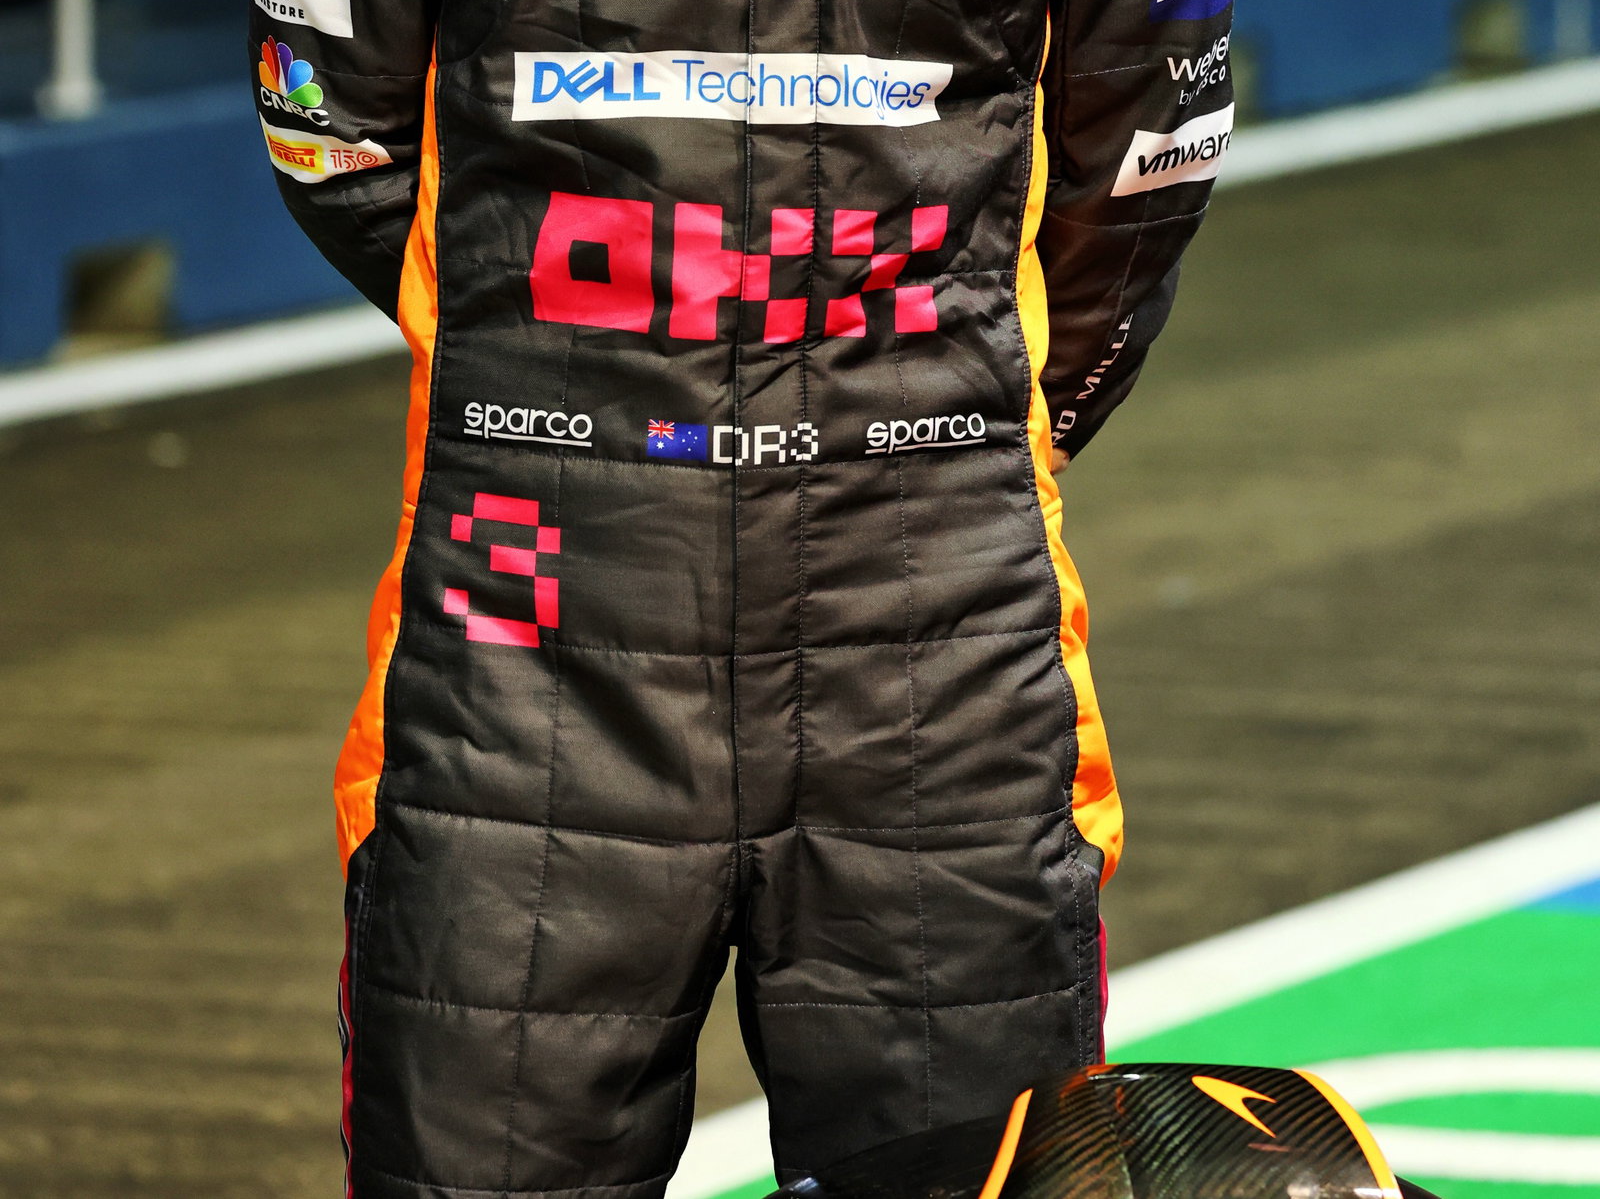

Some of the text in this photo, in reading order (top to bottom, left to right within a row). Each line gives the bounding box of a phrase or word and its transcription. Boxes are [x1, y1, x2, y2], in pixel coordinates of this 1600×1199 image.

[260, 86, 331, 127] CNBC
[531, 59, 932, 121] DELL Technologies
[1075, 313, 1134, 400] MILLE
[463, 401, 593, 447] sparco
[712, 422, 819, 466] DR3
[865, 412, 987, 454] sparco
[443, 492, 561, 648] 3
